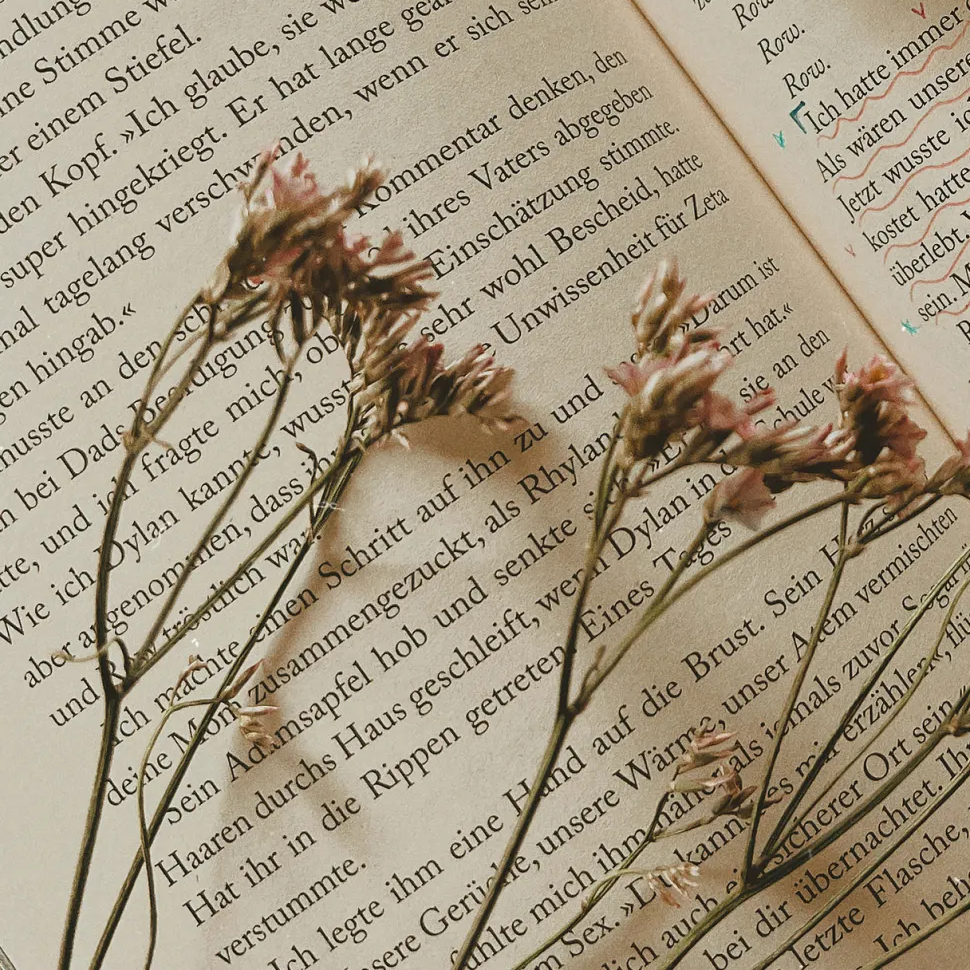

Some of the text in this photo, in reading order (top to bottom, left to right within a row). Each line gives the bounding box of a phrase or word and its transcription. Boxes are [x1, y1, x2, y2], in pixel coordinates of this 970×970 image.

[280, 12, 319, 42] sie
[756, 23, 805, 66] Row.
[507, 50, 628, 120] denken, den
[782, 58, 832, 100] Row.
[803, 99, 842, 135] Ich
[834, 64, 892, 111] hatte
[886, 6, 964, 71] immer
[402, 85, 654, 240] ihres Vaters abgegeben
[816, 151, 848, 184] Als
[845, 108, 908, 158] wären
[489, 231, 659, 345] Unwissenheit
[888, 228, 970, 287] überlebt.
[247, 525, 487, 706] zusammengezuckt,
[680, 618, 766, 684] Brust.
[154, 608, 540, 888] Haaren durchs Haus geschleift,
[358, 726, 462, 800] Rippen
[535, 789, 621, 856] unsere
[793, 779, 944, 904] übernachtet.
[214, 858, 367, 965] verstummte.
